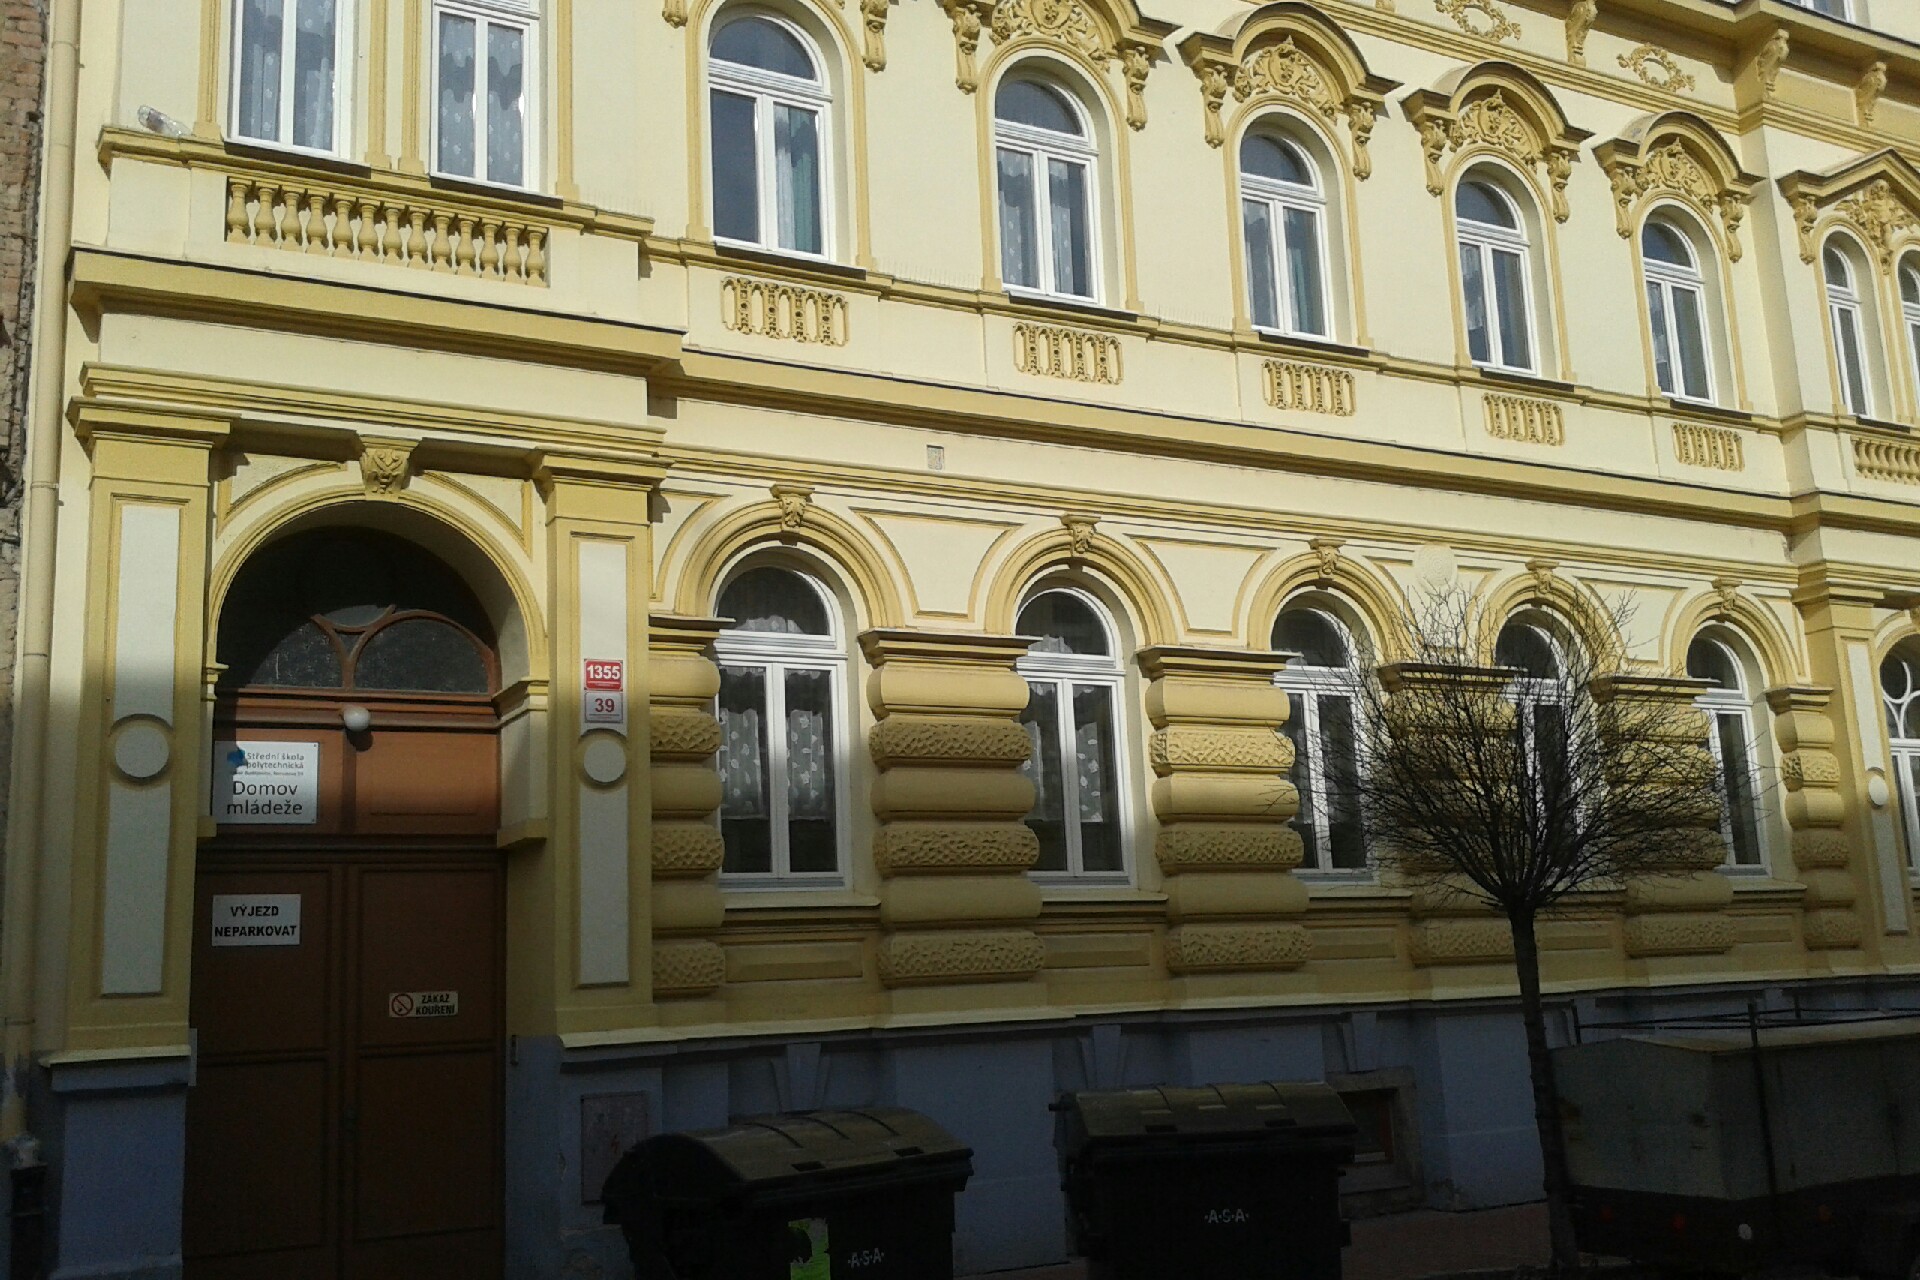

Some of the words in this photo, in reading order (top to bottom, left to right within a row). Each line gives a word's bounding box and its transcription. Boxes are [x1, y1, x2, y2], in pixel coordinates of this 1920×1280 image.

[587, 664, 620, 680] 1355
[594, 698, 615, 713] 39
[247, 752, 279, 760] Střední
[282, 752, 305, 761] škola
[246, 761, 304, 769] polytechnická
[233, 780, 298, 796] Domov
[226, 799, 303, 815] mládeže
[230, 904, 279, 917] VÝJEZD
[214, 925, 297, 937] NEPARKOVAT
